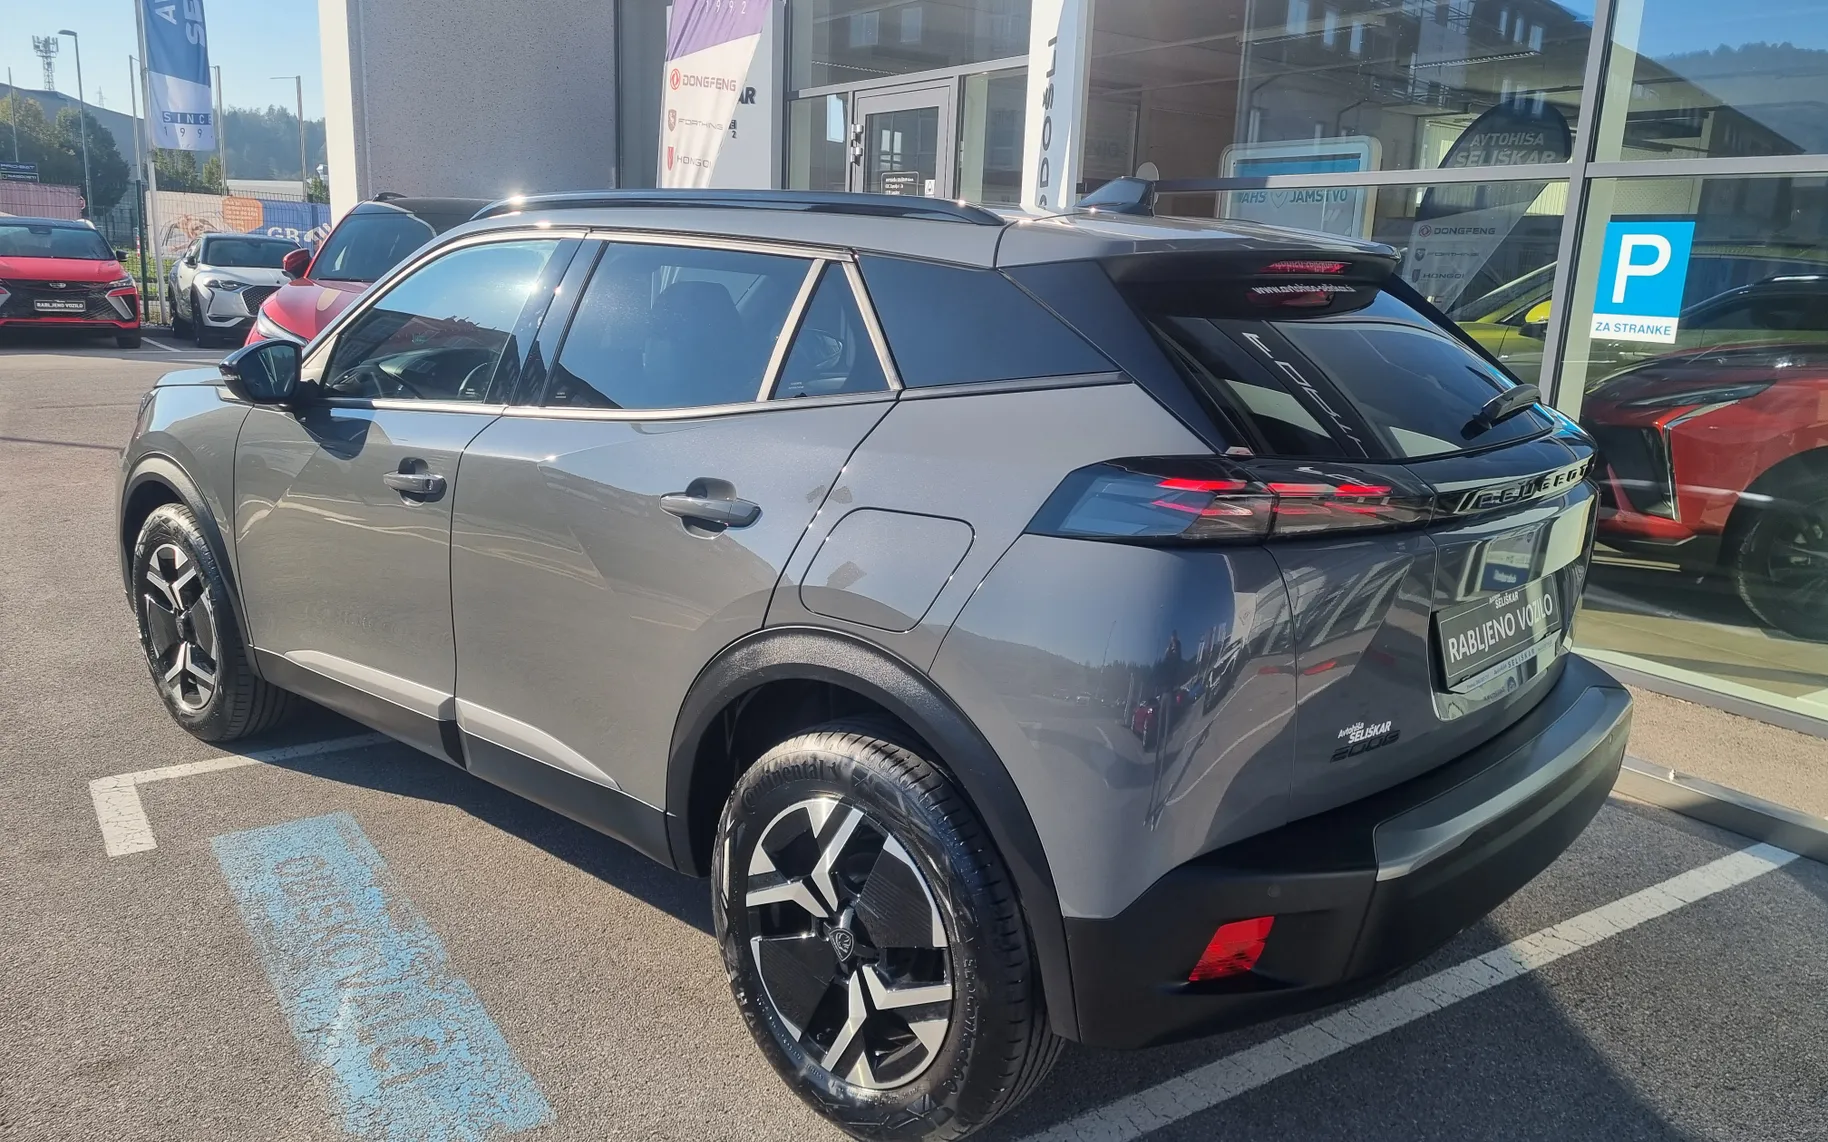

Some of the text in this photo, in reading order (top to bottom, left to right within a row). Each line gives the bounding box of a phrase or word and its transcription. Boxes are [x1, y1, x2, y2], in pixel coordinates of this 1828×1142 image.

[705, 0, 747, 14] 1992
[682, 74, 737, 92] DONGFENG
[164, 126, 213, 138] 199
[678, 117, 723, 131] FORTHING
[1290, 189, 1348, 203] JAMSTVO
[1434, 227, 1496, 235] DONGFENG
[1611, 233, 1672, 303] P
[1595, 322, 1672, 336] ZA STRANKE
[1448, 593, 1553, 664] RABLJENO VOZILO
[1337, 721, 1365, 739] Avtohiša
[1347, 720, 1393, 744] SELIŠKAR
[1330, 729, 1401, 764] 2008
[741, 759, 824, 810] Continental
